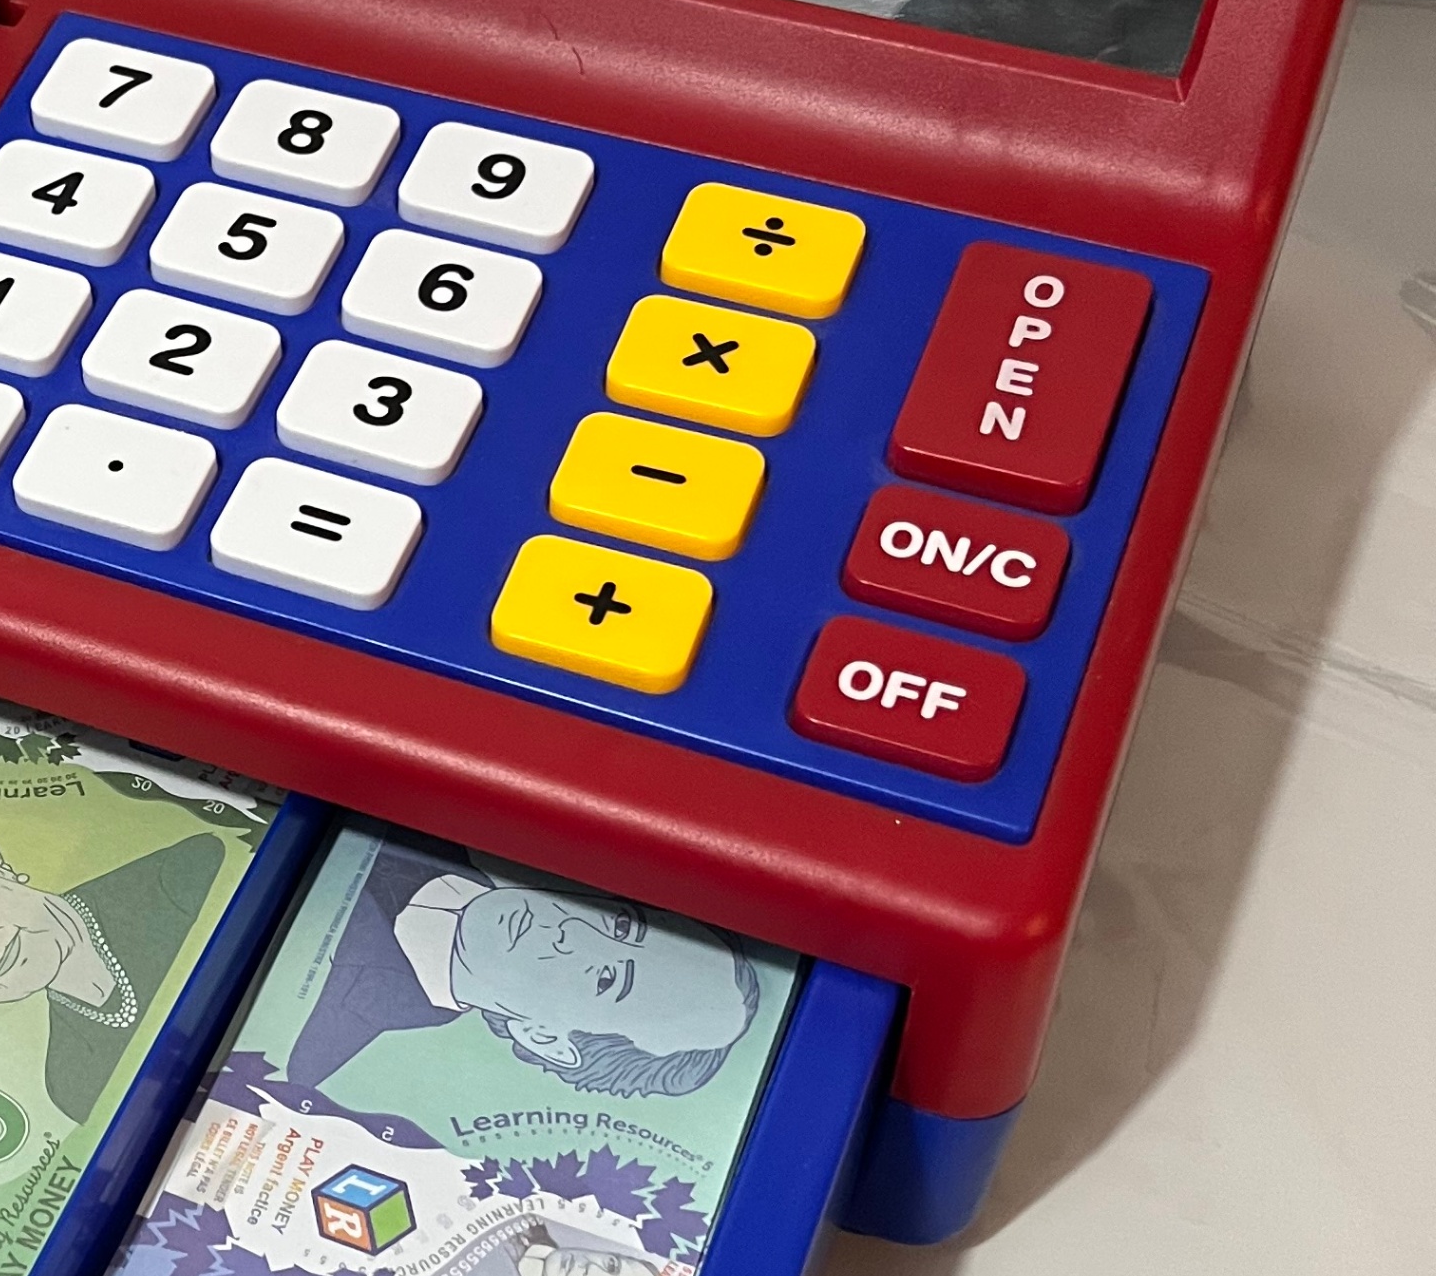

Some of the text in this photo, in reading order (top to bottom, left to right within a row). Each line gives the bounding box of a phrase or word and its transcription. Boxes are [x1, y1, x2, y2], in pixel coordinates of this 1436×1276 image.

[99, 65, 153, 109] 7
[278, 109, 333, 155] 8
[31, 171, 85, 216] 4
[470, 153, 527, 200] 9
[217, 213, 278, 261] 5
[418, 264, 475, 311] 6
[149, 325, 212, 377] 2
[979, 274, 1066, 442] OPEN
[353, 376, 413, 427] 3
[880, 521, 1037, 588] ON/C
[838, 659, 967, 720] OFF
[202, 800, 225, 815] 20
[299, 1100, 313, 1114] 5
[450, 1107, 588, 1137] Learning
[270, 1128, 301, 1176] Argent
[15, 1155, 82, 1251] MONEY
[272, 1138, 324, 1235] PLAY MONEY
[466, 1199, 545, 1235] LEARNING
